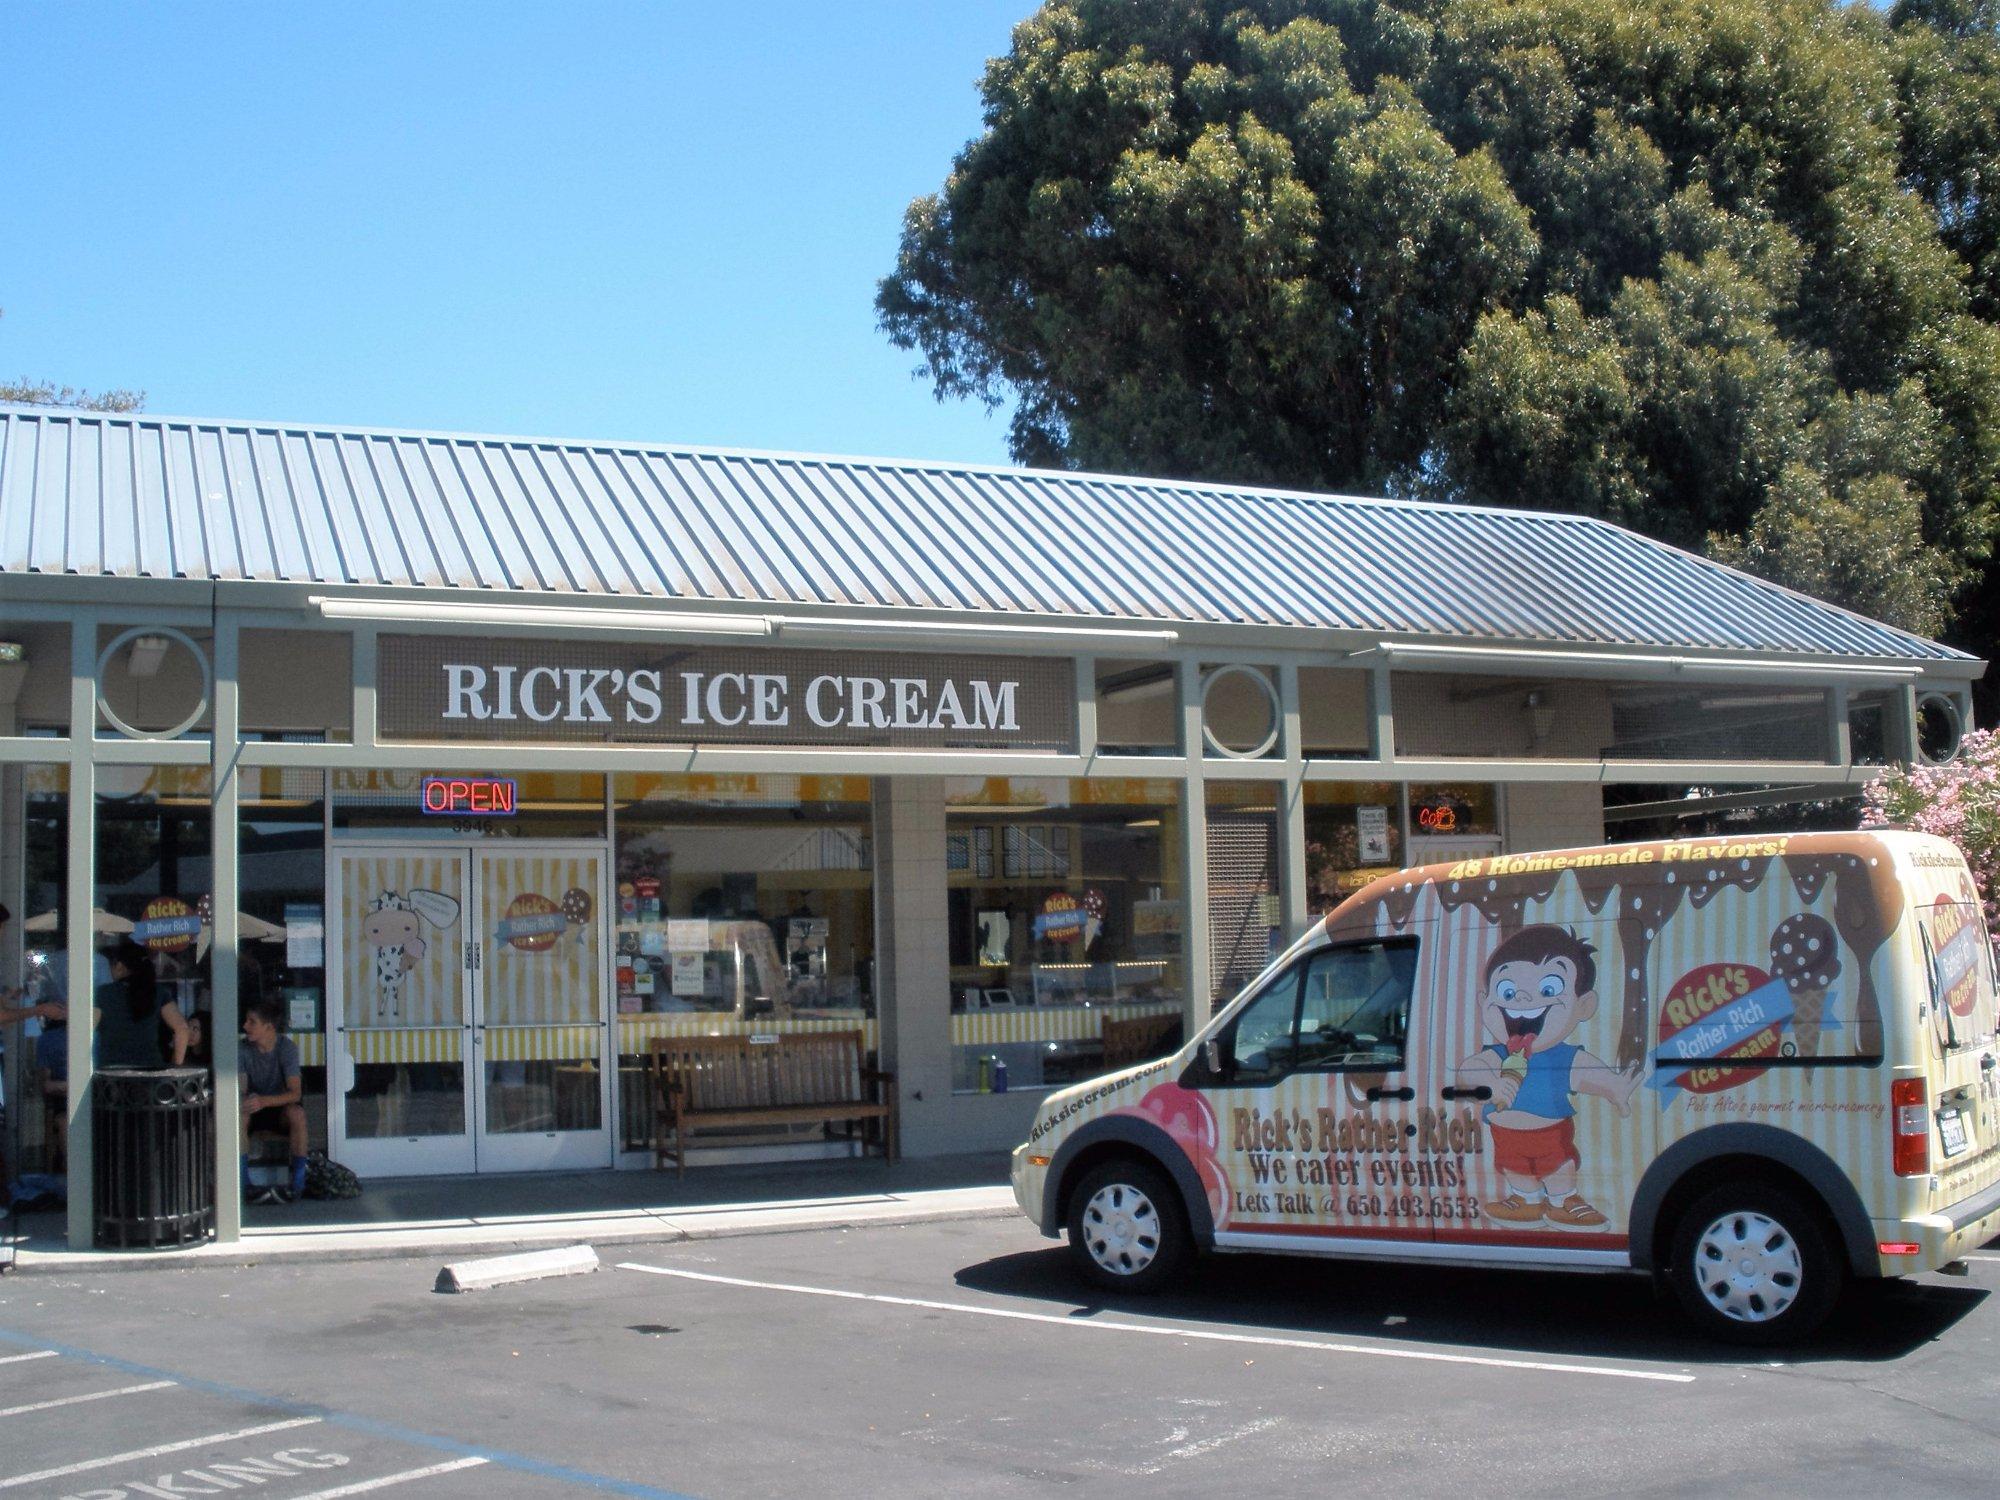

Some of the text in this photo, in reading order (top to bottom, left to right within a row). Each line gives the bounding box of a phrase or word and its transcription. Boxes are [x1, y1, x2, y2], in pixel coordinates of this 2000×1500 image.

[442, 664, 1020, 731] RICK'S ICE CREAM
[426, 781, 512, 812] OPEN
[452, 820, 493, 833] 3946
[1448, 837, 1788, 879] 48 Home-made Flavors!
[147, 902, 186, 919] Rick's
[1667, 967, 1750, 1029] Rick's
[1676, 999, 1765, 1059] Rather Rich
[1031, 1061, 1168, 1143] Ricksicecream.com
[1749, 1100, 1794, 1118] gourmet
[1233, 1107, 1483, 1154] Rick's Rather Rich
[1249, 1153, 1465, 1188] We cater events!
[1236, 1191, 1480, 1219] Lets Talk @ 650.493.6553
